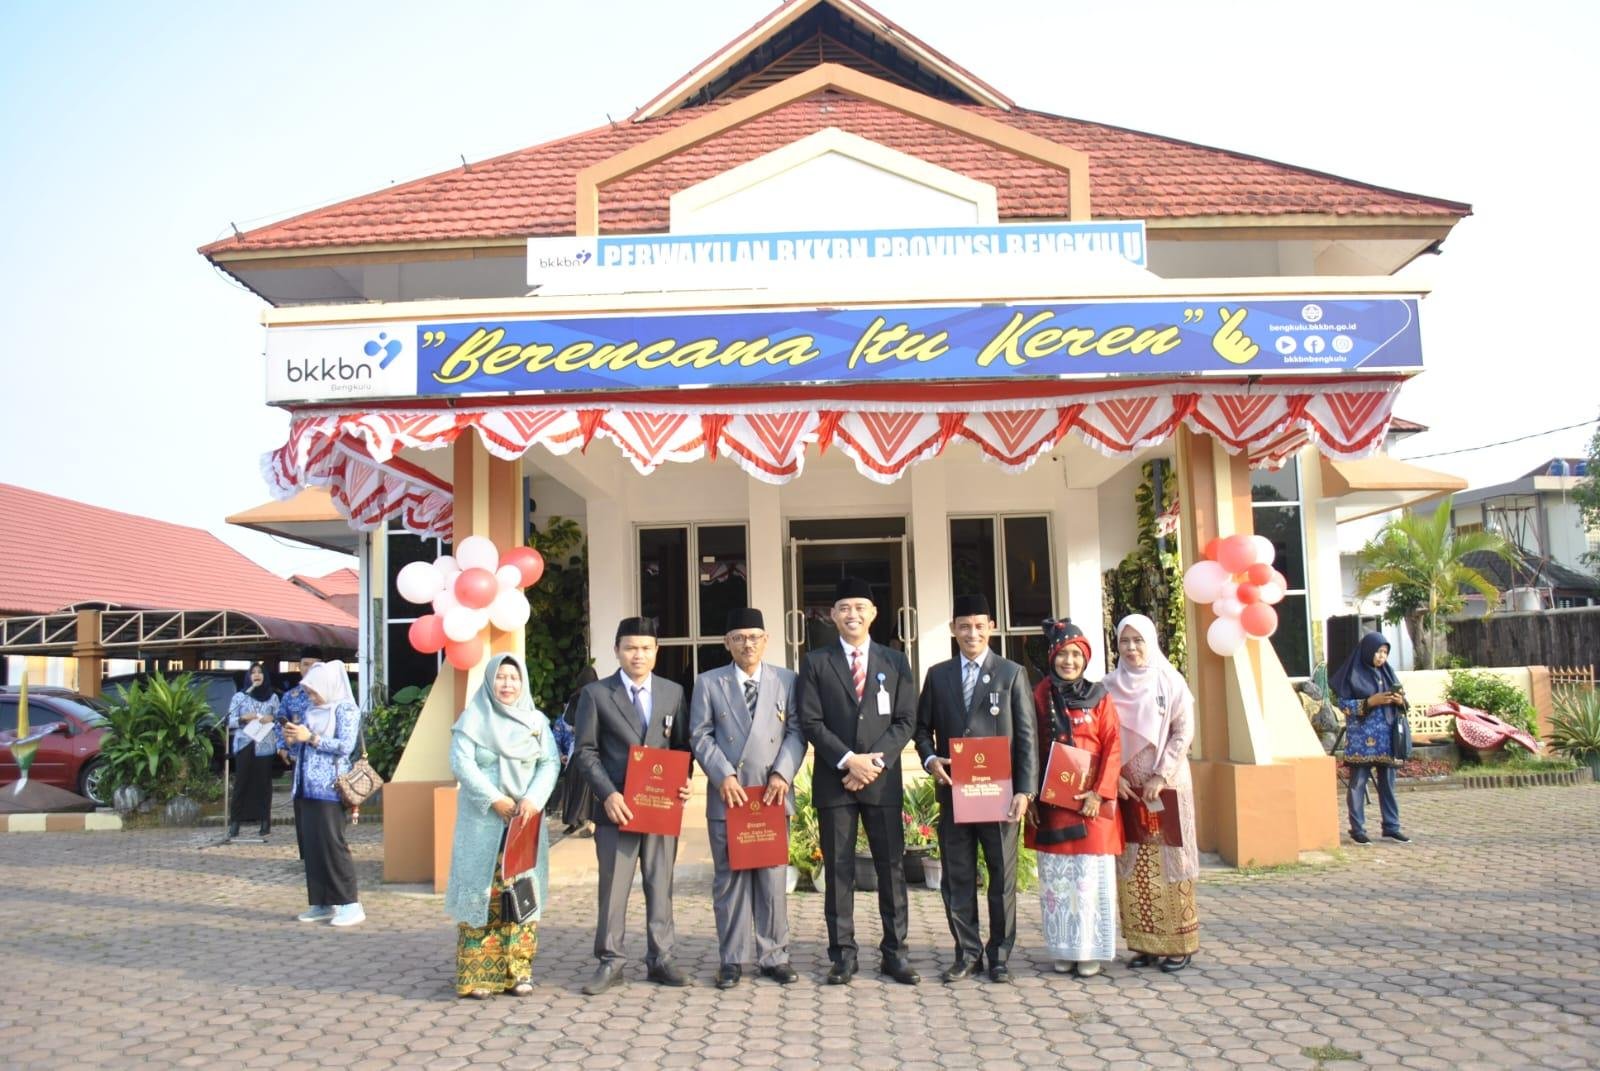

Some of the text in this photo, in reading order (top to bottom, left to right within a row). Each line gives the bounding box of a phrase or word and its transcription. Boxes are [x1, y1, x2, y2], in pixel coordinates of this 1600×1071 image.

[539, 257, 580, 269] bkkbn
[1269, 323, 1357, 333] bengkulu.bkkbn.go.id
[847, 316, 950, 370] Itu
[1283, 355, 1347, 364] bkkbnbengkulu
[287, 357, 372, 383] bkkbn
[331, 383, 372, 393] Bengkulu
